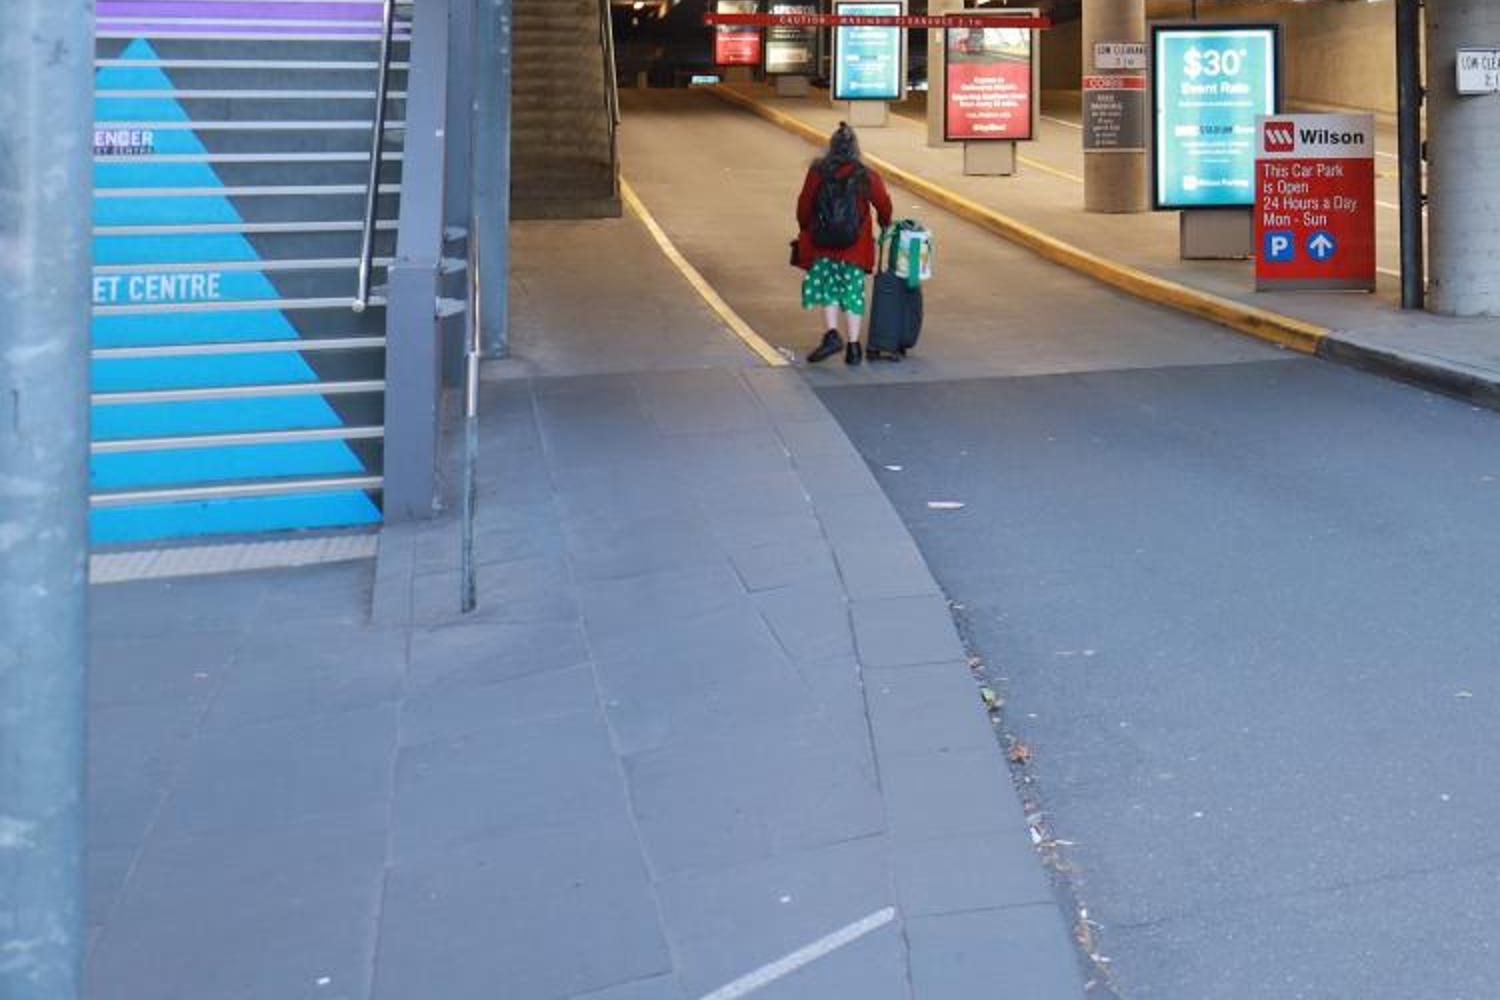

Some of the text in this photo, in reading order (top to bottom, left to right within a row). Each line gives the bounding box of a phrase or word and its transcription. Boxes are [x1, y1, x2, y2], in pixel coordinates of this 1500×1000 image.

[779, 16, 825, 25] CAUTION
[1300, 129, 1365, 145] Wilson
[1264, 163, 1344, 177] This Car Park
[1264, 180, 1273, 193] is
[1277, 180, 1309, 195] Open
[1264, 196, 1279, 210] 24
[1284, 197, 1319, 210] Hours
[1322, 200, 1331, 209] a
[1263, 212, 1291, 226] Mon
[1303, 211, 1328, 226] Sun
[1271, 236, 1289, 257] P
[129, 273, 221, 299] CENTRE
